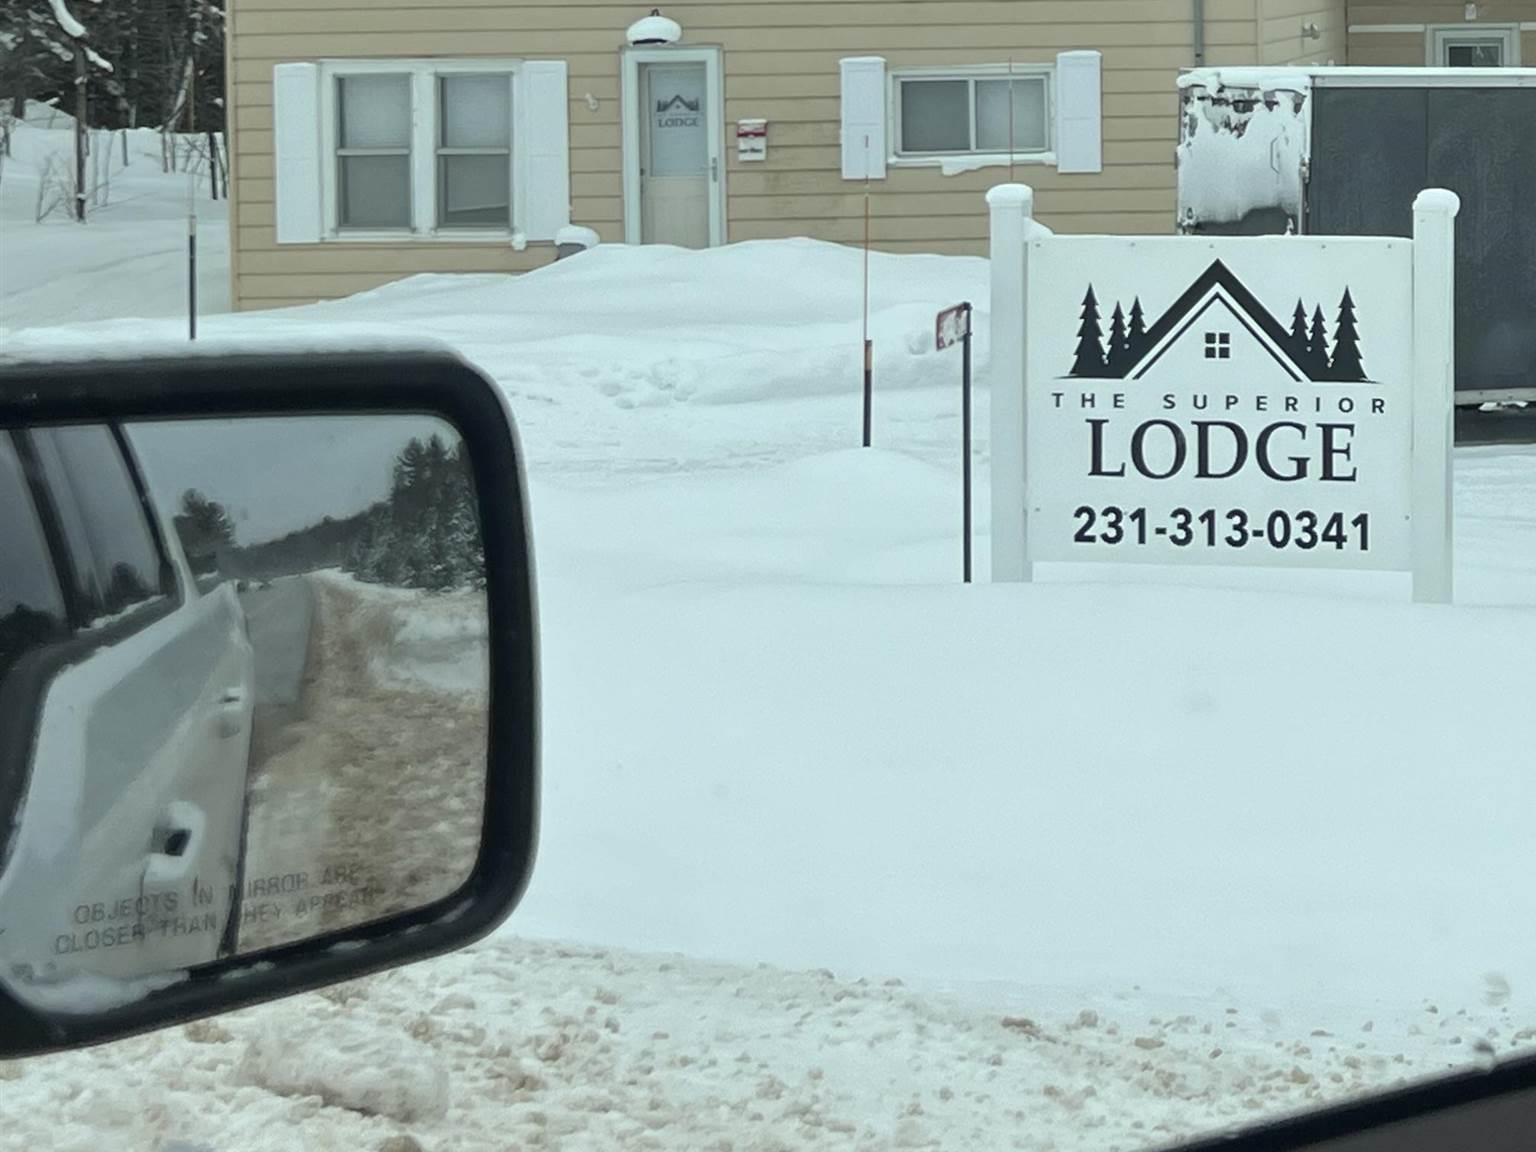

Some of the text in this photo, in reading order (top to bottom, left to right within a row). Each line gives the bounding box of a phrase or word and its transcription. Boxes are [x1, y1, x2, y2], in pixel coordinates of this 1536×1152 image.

[1051, 391, 1386, 415] THE SUPERIOR
[1084, 418, 1358, 483] LODGE
[1072, 505, 1371, 551] 231-313-0341
[74, 891, 178, 925] OBJECTS
[193, 884, 213, 907] IN
[55, 923, 146, 955] CLOSER
[157, 912, 218, 938] THAN
